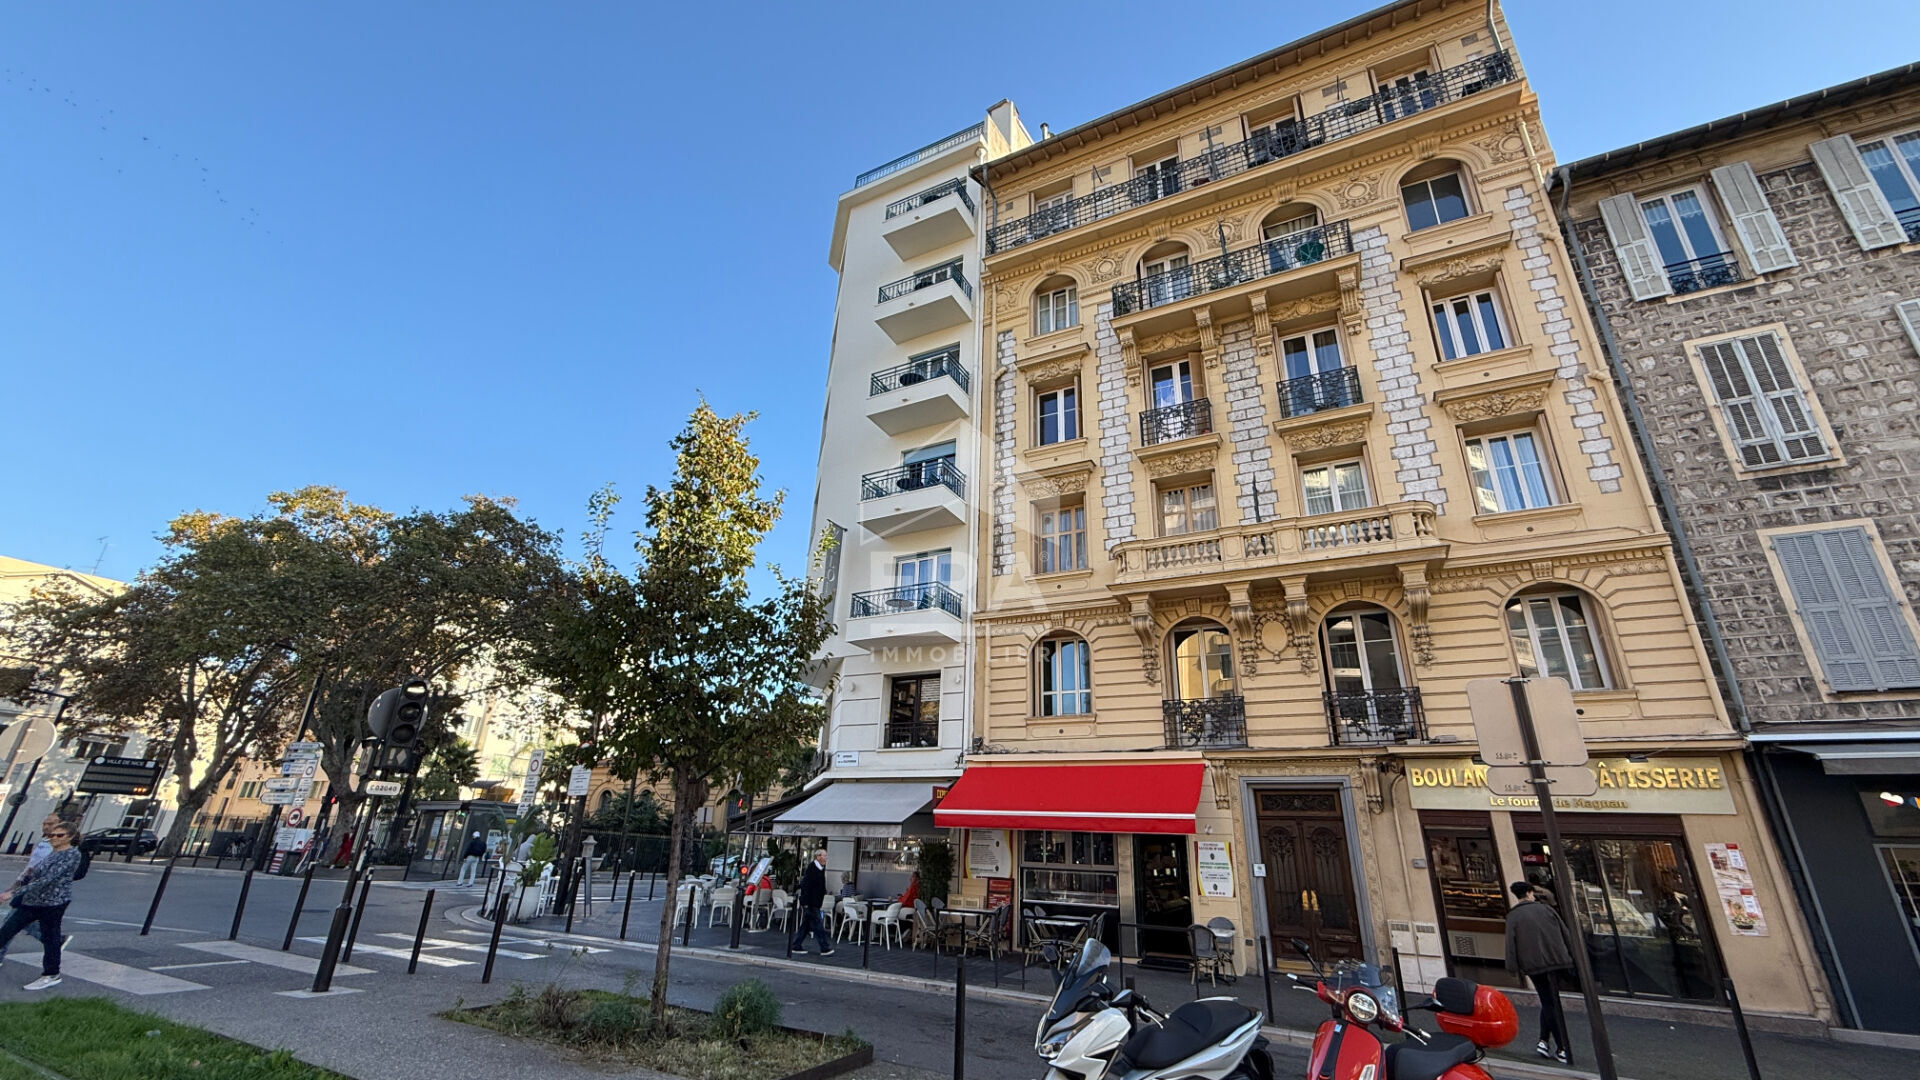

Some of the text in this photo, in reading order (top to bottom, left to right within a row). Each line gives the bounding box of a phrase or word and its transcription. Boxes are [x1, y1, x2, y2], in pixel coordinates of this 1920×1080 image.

[1410, 767, 1489, 788] BOULAN
[1588, 761, 1722, 789] ÂTISSERIE
[1489, 795, 1505, 806] Le
[1507, 796, 1540, 806] fourn
[1573, 798, 1629, 811] Magnan
